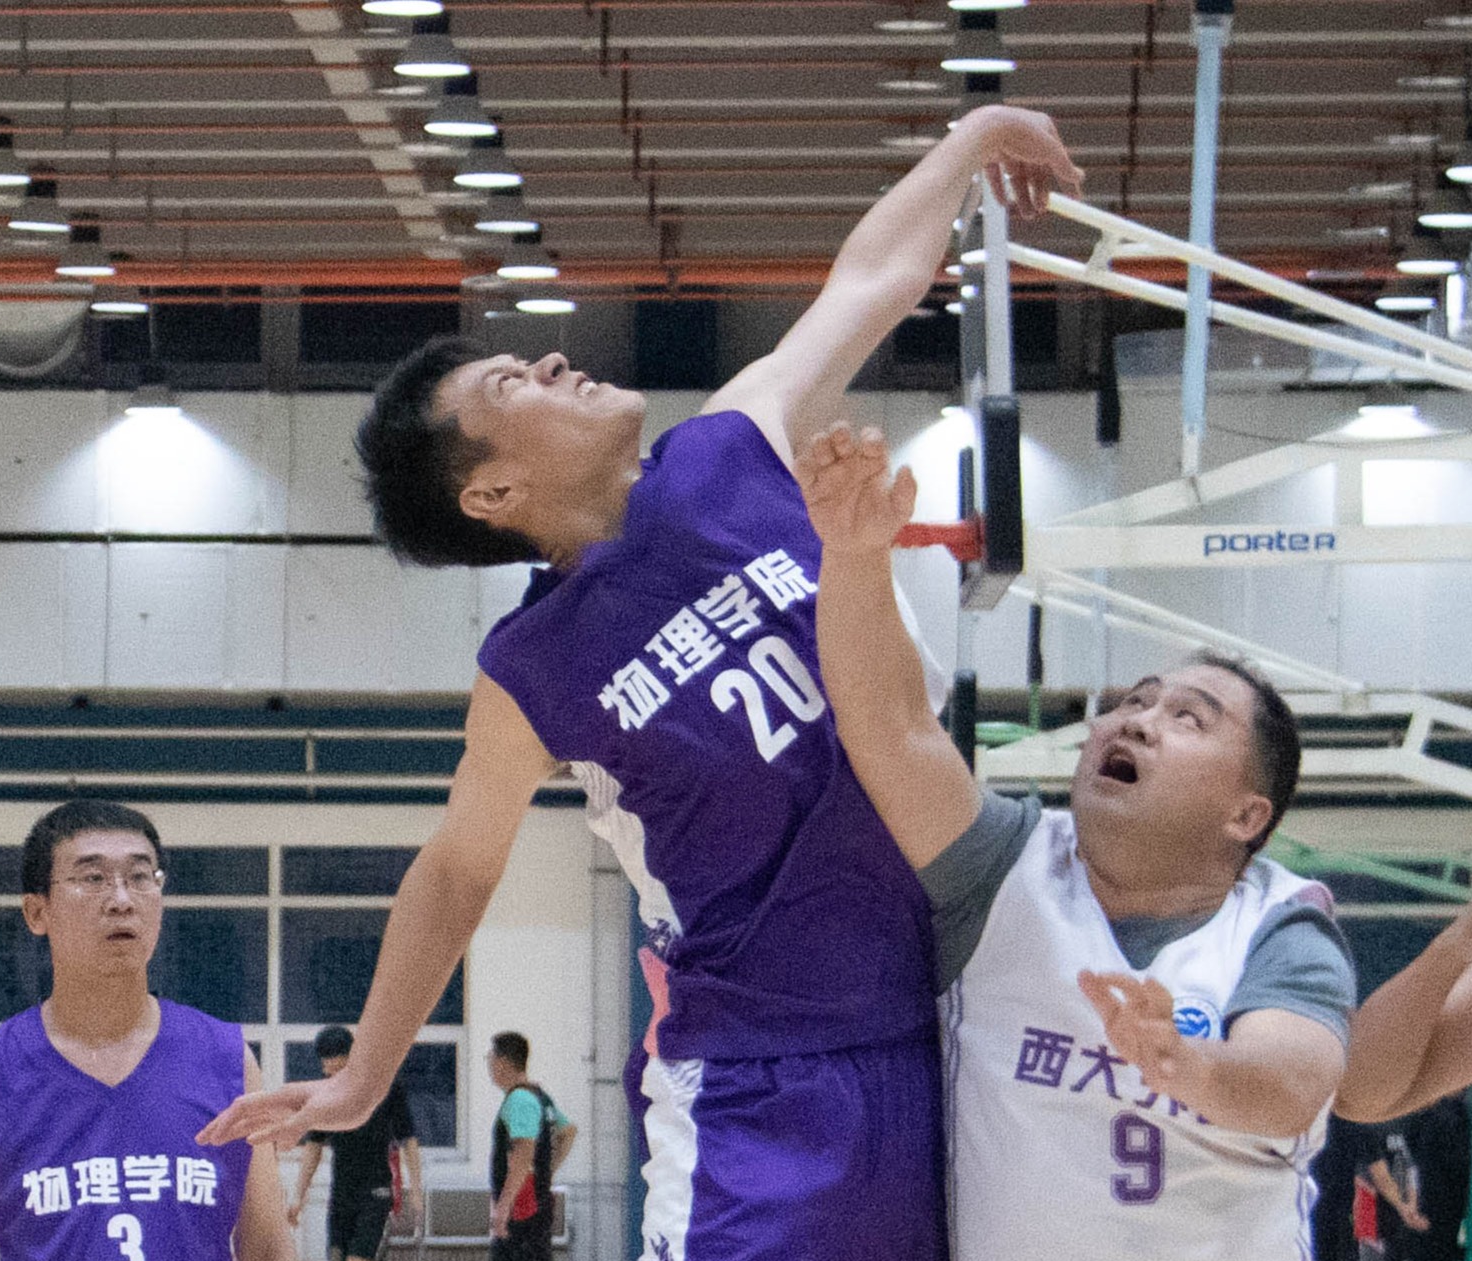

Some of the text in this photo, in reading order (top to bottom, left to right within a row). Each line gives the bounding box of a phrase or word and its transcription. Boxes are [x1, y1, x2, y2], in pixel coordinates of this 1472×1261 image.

[597, 548, 819, 731] 物理学院
[710, 635, 826, 764] 20
[22, 1154, 218, 1216] 物理学院
[1110, 1110, 1165, 1207] 9
